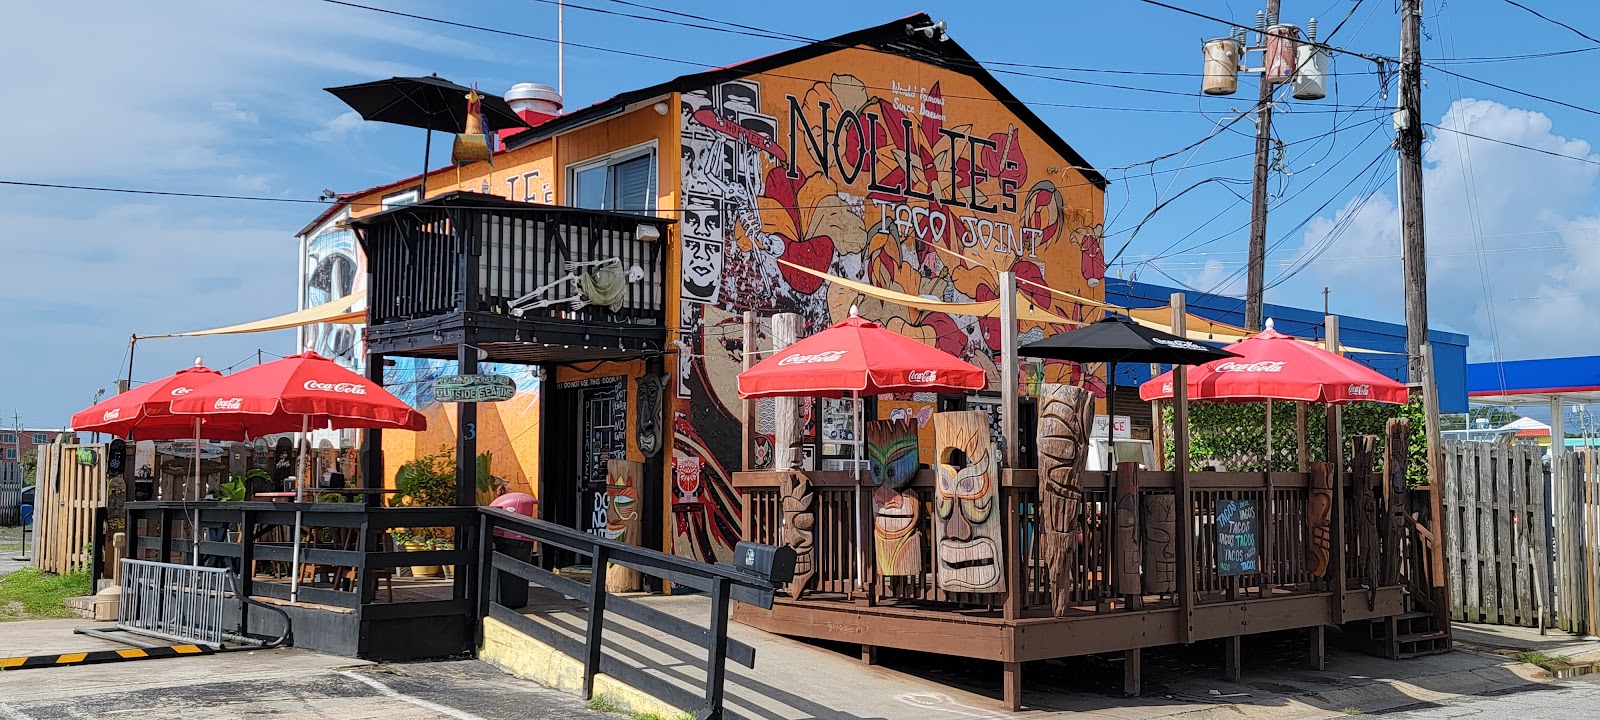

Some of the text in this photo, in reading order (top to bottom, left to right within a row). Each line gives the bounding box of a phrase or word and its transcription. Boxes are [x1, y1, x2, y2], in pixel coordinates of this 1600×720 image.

[892, 80, 946, 106] World Famous
[892, 97, 915, 113] Since
[873, 198, 1043, 258] TACO JOINT
[778, 350, 849, 366] Coca-Cola
[1215, 361, 1287, 373] Coca-Cola
[908, 370, 937, 382] Coca-Cola
[303, 379, 367, 395] Coca-Cola
[436, 386, 513, 400] OUTSIDE SEATING
[1348, 383, 1370, 396] Coca-Cola
[616, 389, 626, 401] NOT
[214, 398, 242, 410] Coca-Cola
[103, 408, 121, 421] Coca-Cola
[465, 422, 476, 440] 3
[614, 419, 625, 431] NO
[1113, 421, 1125, 431] CE
[614, 449, 626, 460] STOP
[592, 508, 607, 528] NO
[1216, 500, 1237, 528] TACOS
[1239, 506, 1256, 520] TACOS
[1228, 520, 1250, 534] TACOS
[1219, 532, 1255, 547] TACOS TACOS
[1224, 549, 1243, 562] TACOS
